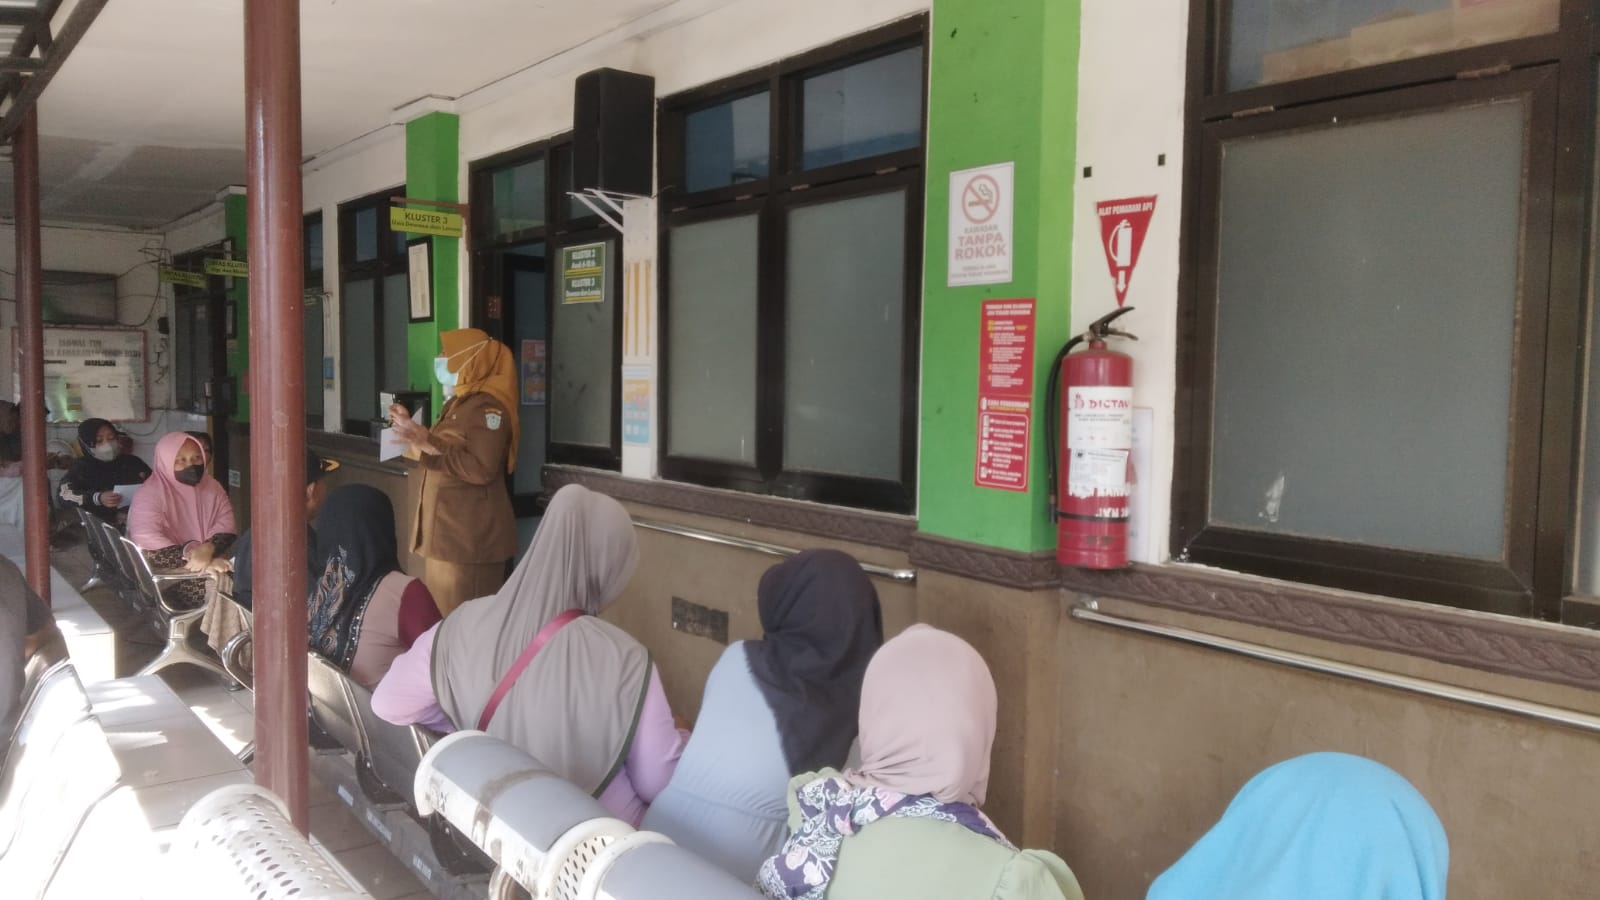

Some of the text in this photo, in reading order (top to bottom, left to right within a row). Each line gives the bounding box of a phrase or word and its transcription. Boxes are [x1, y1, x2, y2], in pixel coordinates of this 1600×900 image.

[405, 212, 448, 224] KLUSTER 3
[957, 232, 1004, 247] TANPA
[954, 243, 1006, 260] ROKOK
